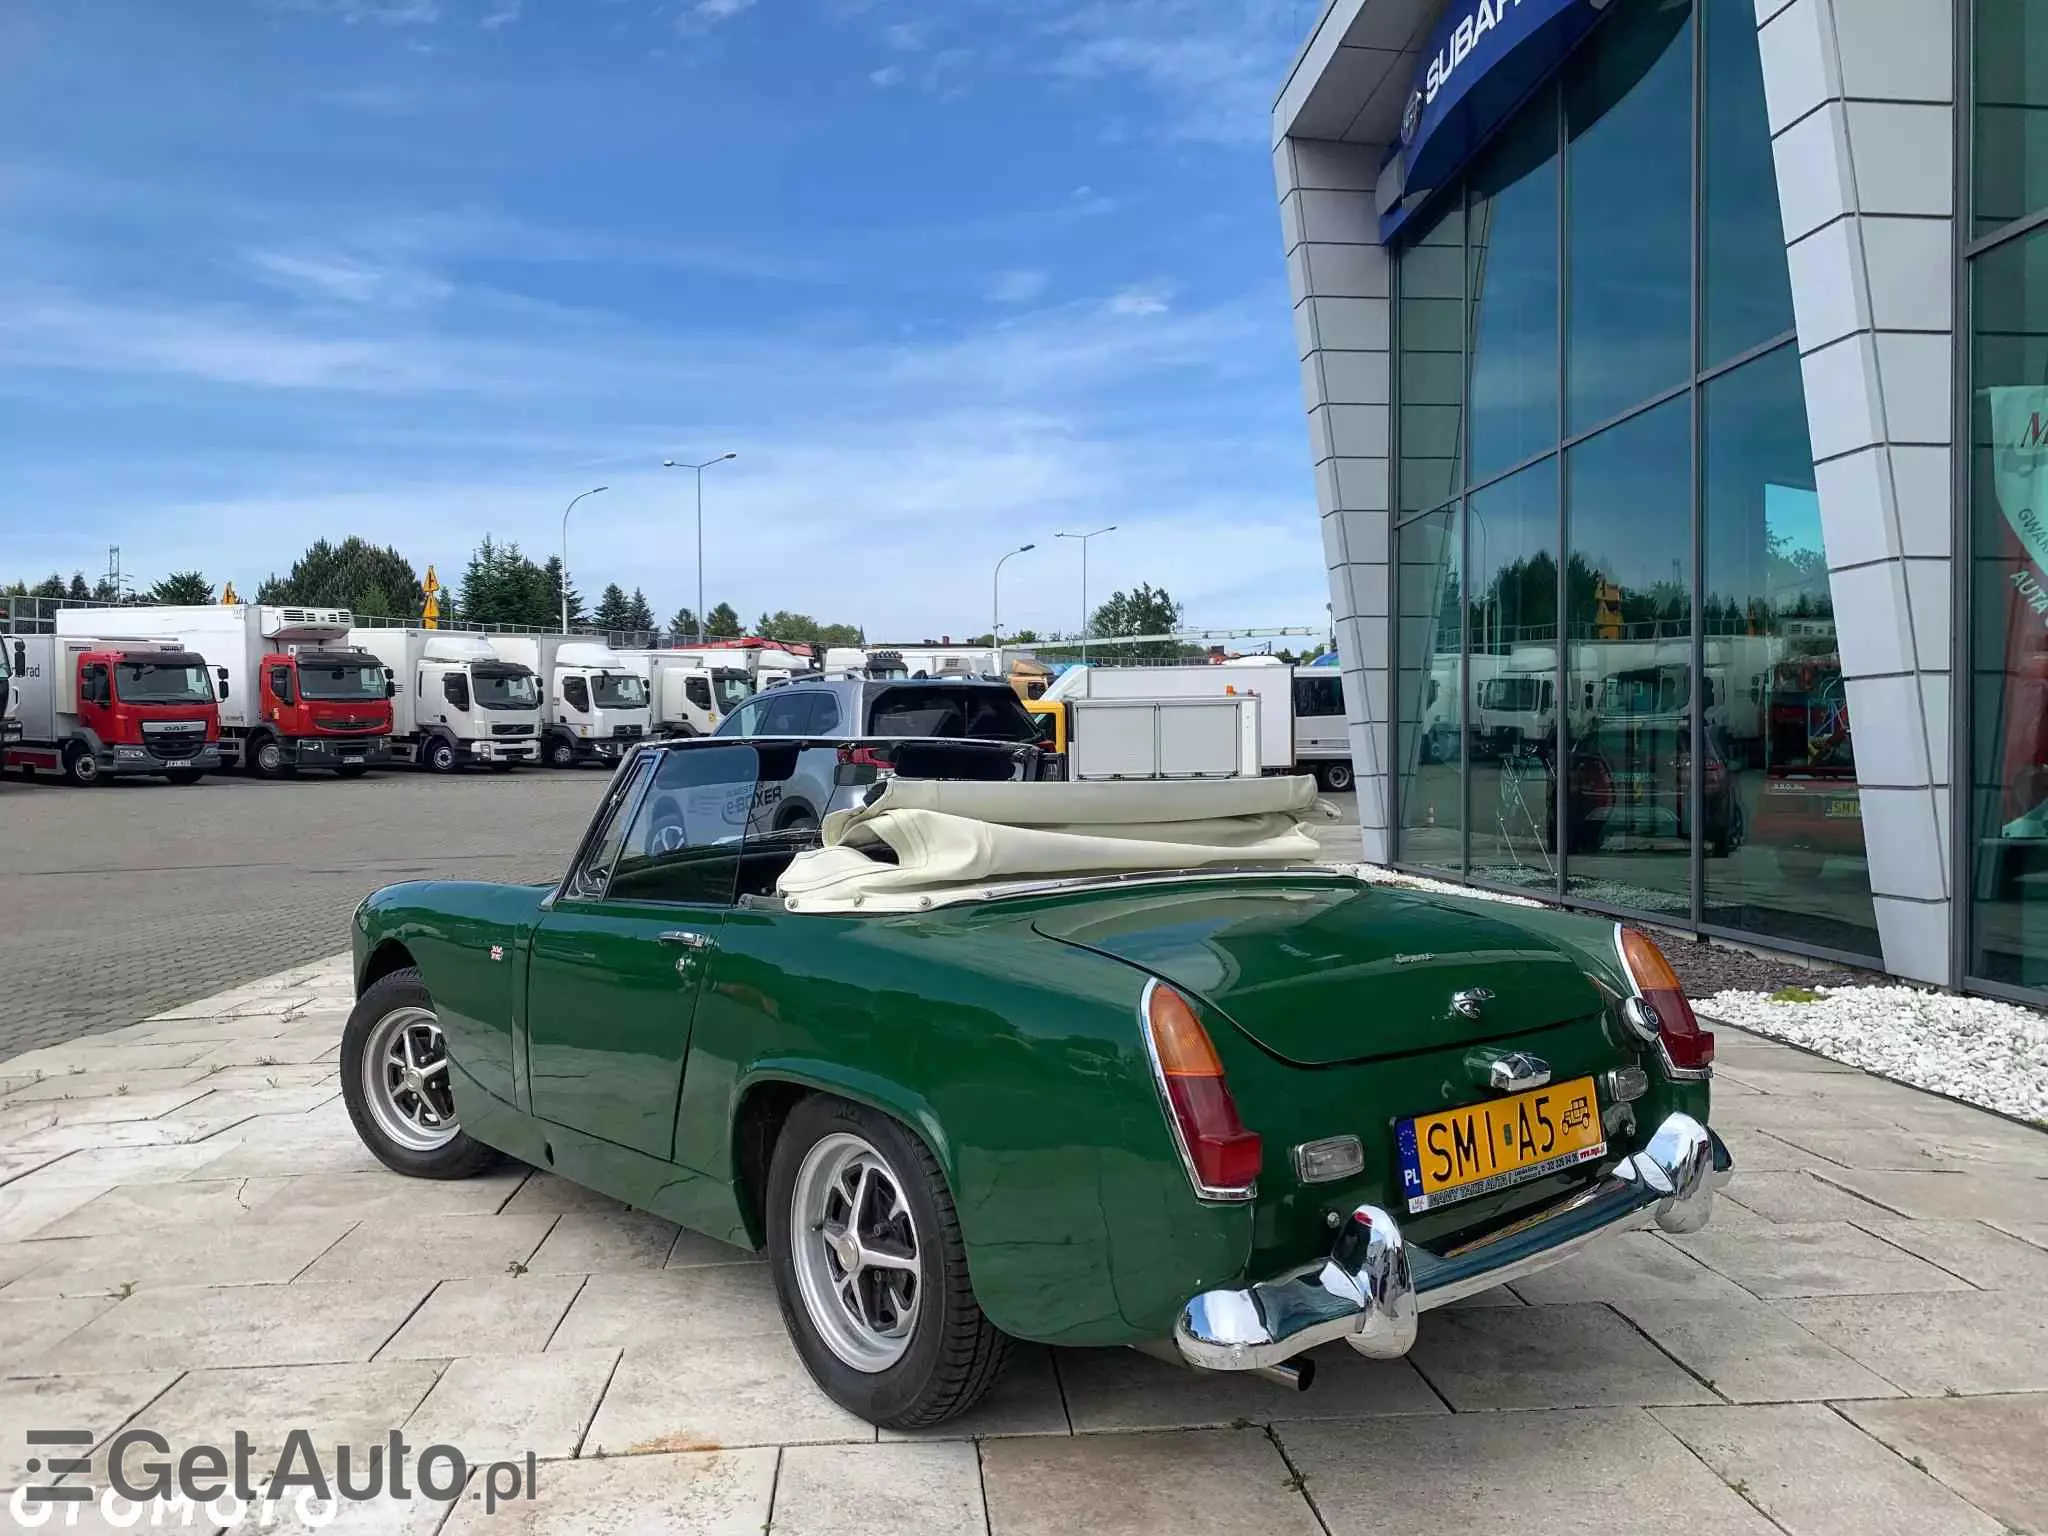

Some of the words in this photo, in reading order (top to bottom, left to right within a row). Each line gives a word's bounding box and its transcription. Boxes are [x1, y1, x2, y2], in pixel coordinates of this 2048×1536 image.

[1427, 1111, 1497, 1182] SMI
[1518, 1096, 1556, 1161] A5
[1405, 1169, 1421, 1187] PL
